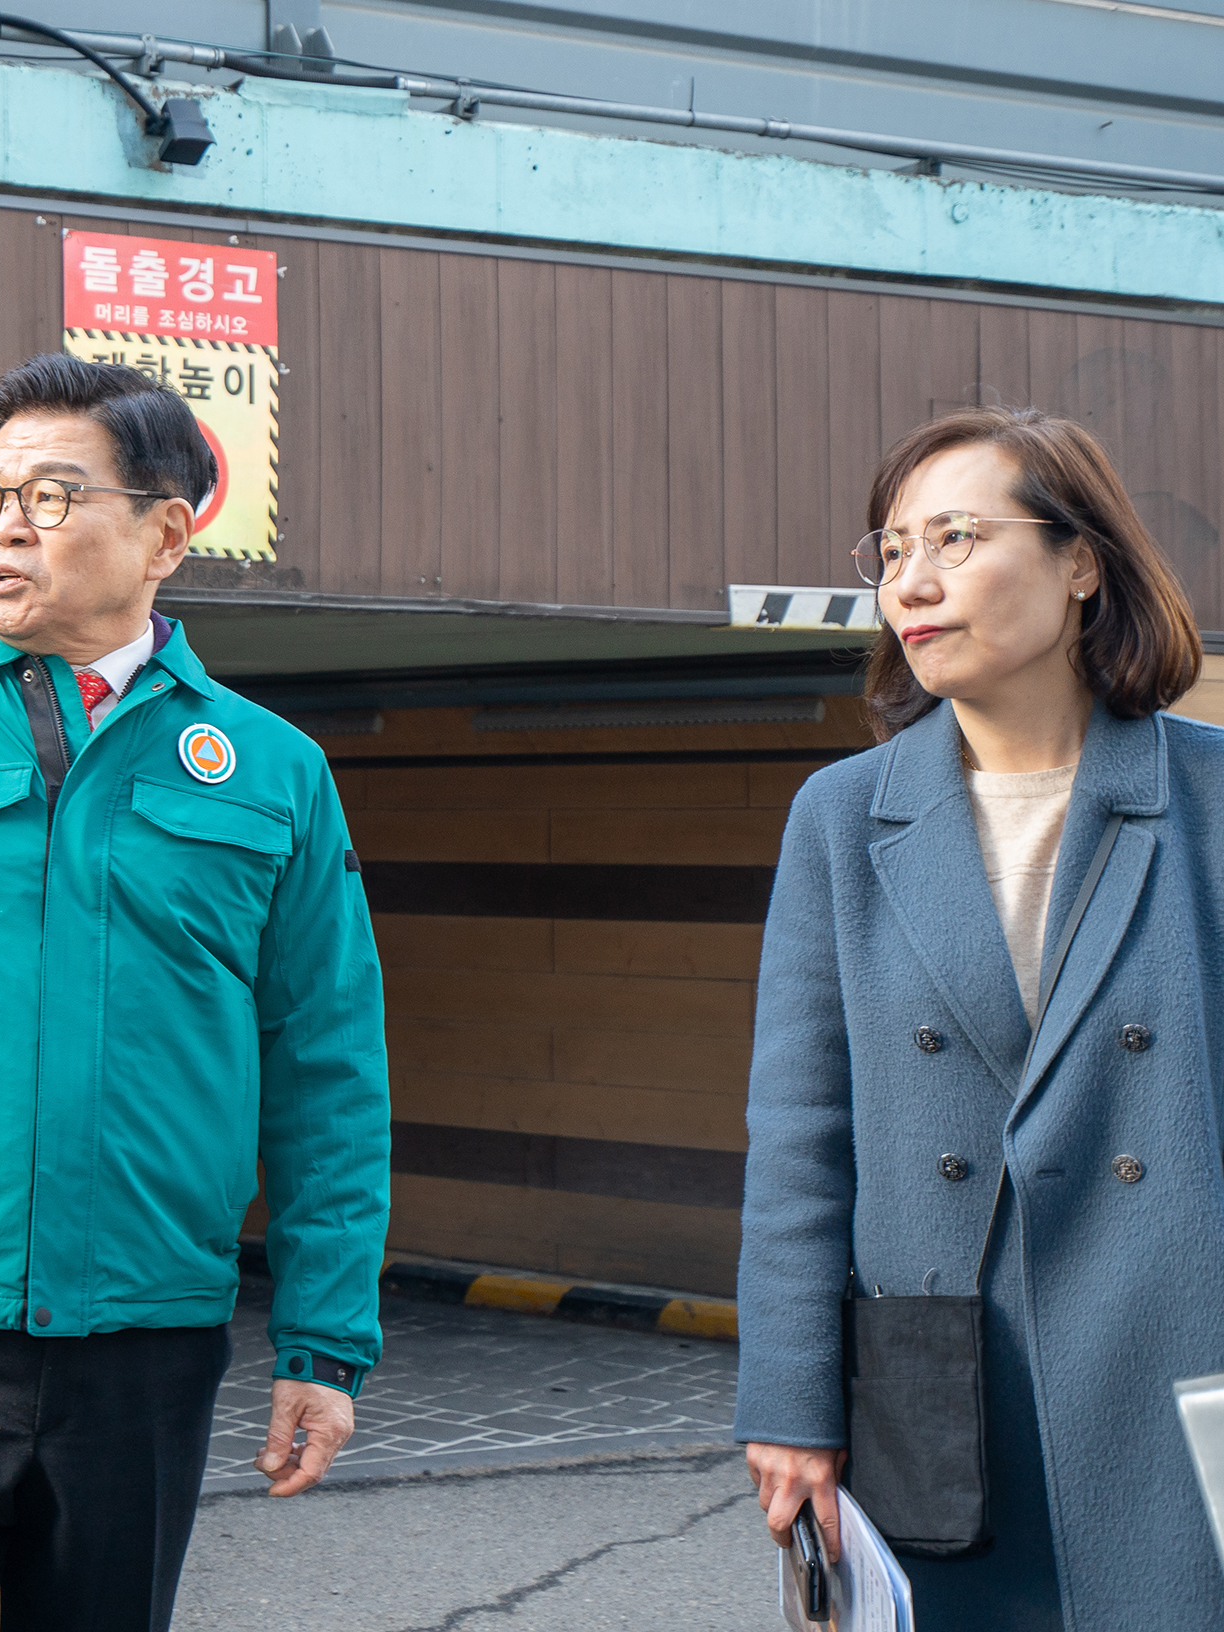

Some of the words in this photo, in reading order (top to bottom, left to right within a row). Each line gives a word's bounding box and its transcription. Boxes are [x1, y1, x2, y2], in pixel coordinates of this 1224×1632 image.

[80, 245, 263, 304] 돌출경고
[94, 302, 150, 326] 머리를
[159, 311, 248, 335] 조심하시오
